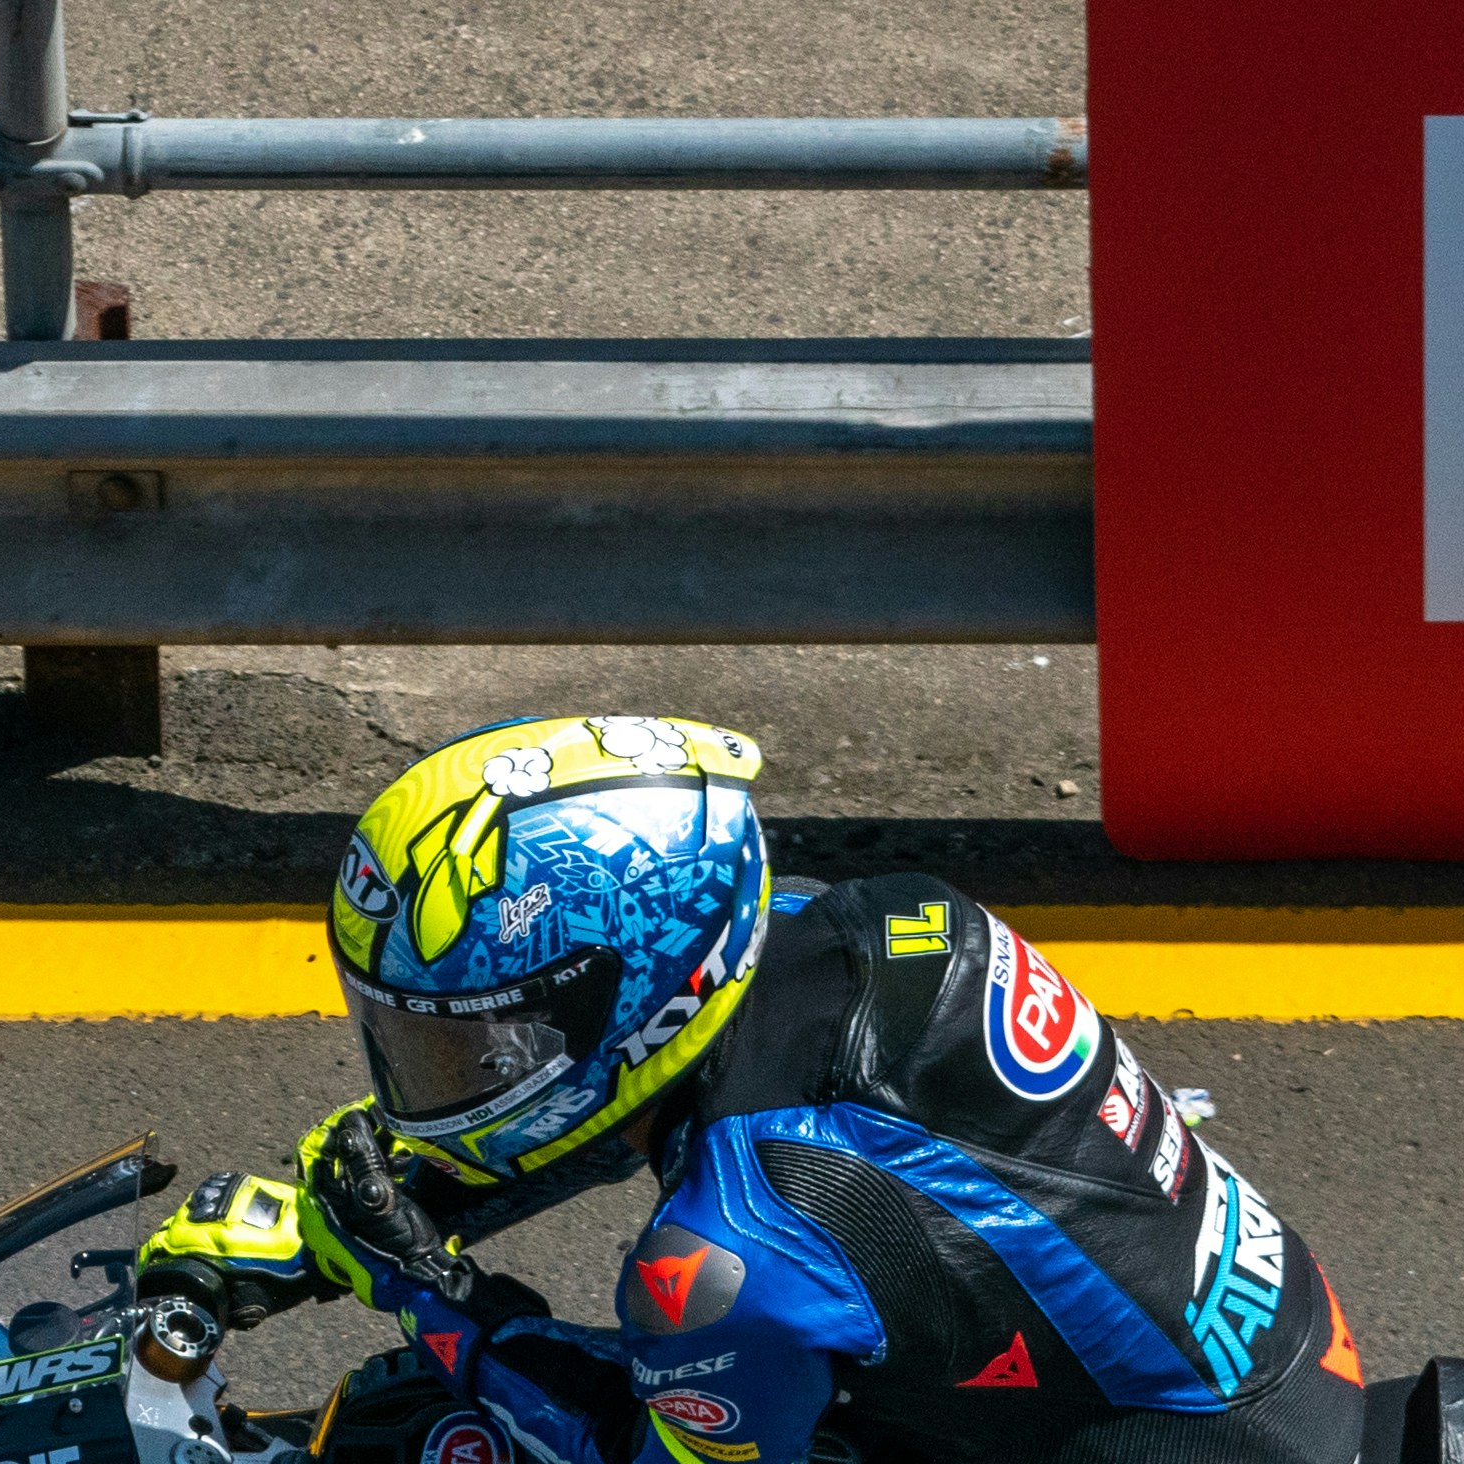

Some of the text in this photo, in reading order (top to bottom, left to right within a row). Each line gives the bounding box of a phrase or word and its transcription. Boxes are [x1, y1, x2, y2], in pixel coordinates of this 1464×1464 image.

[551, 958, 592, 985] KYT
[448, 988, 525, 1014] DIERRE
[1016, 938, 1064, 1041] PAT
[464, 1107, 495, 1125] HDI
[655, 1401, 718, 1421] PATA
